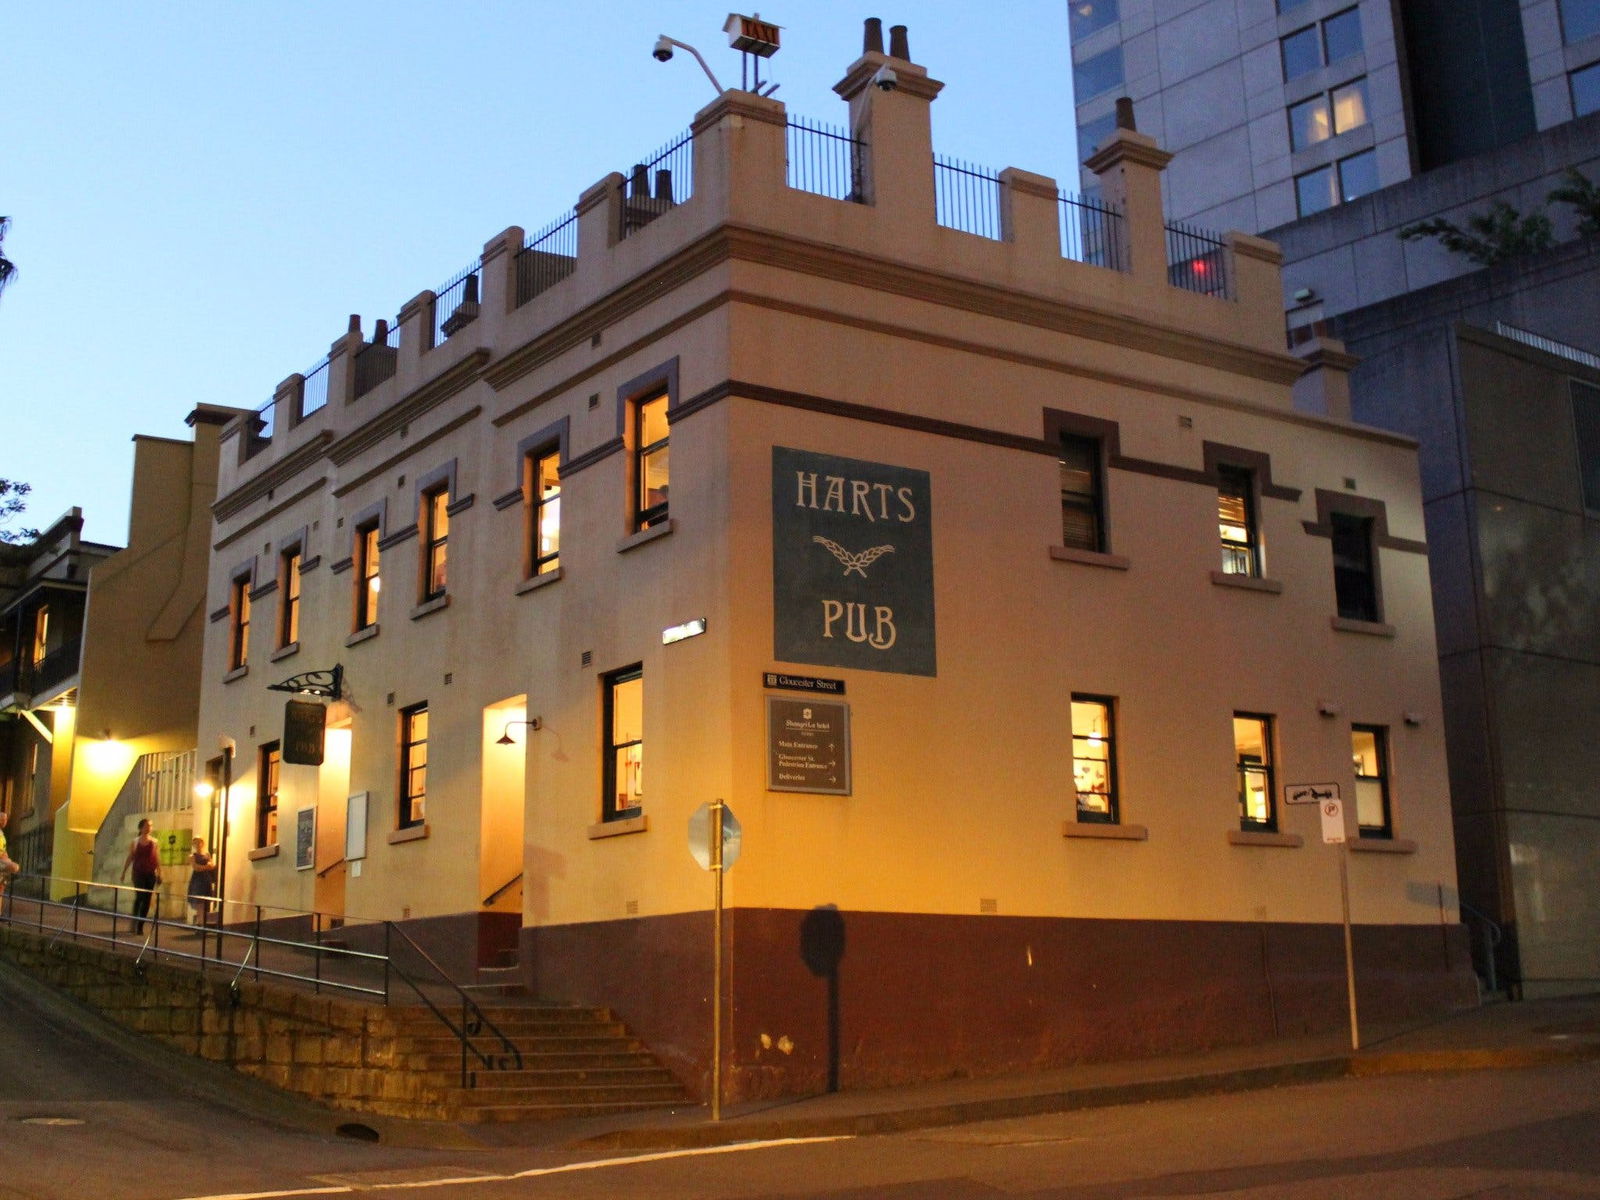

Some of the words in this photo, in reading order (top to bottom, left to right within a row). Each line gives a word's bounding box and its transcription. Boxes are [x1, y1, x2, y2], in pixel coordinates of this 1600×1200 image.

[795, 471, 916, 523] HARTS
[822, 600, 897, 650] PUB
[779, 676, 815, 688] Gloucester
[816, 680, 837, 690] Street
[779, 773, 806, 781] Deliveries
